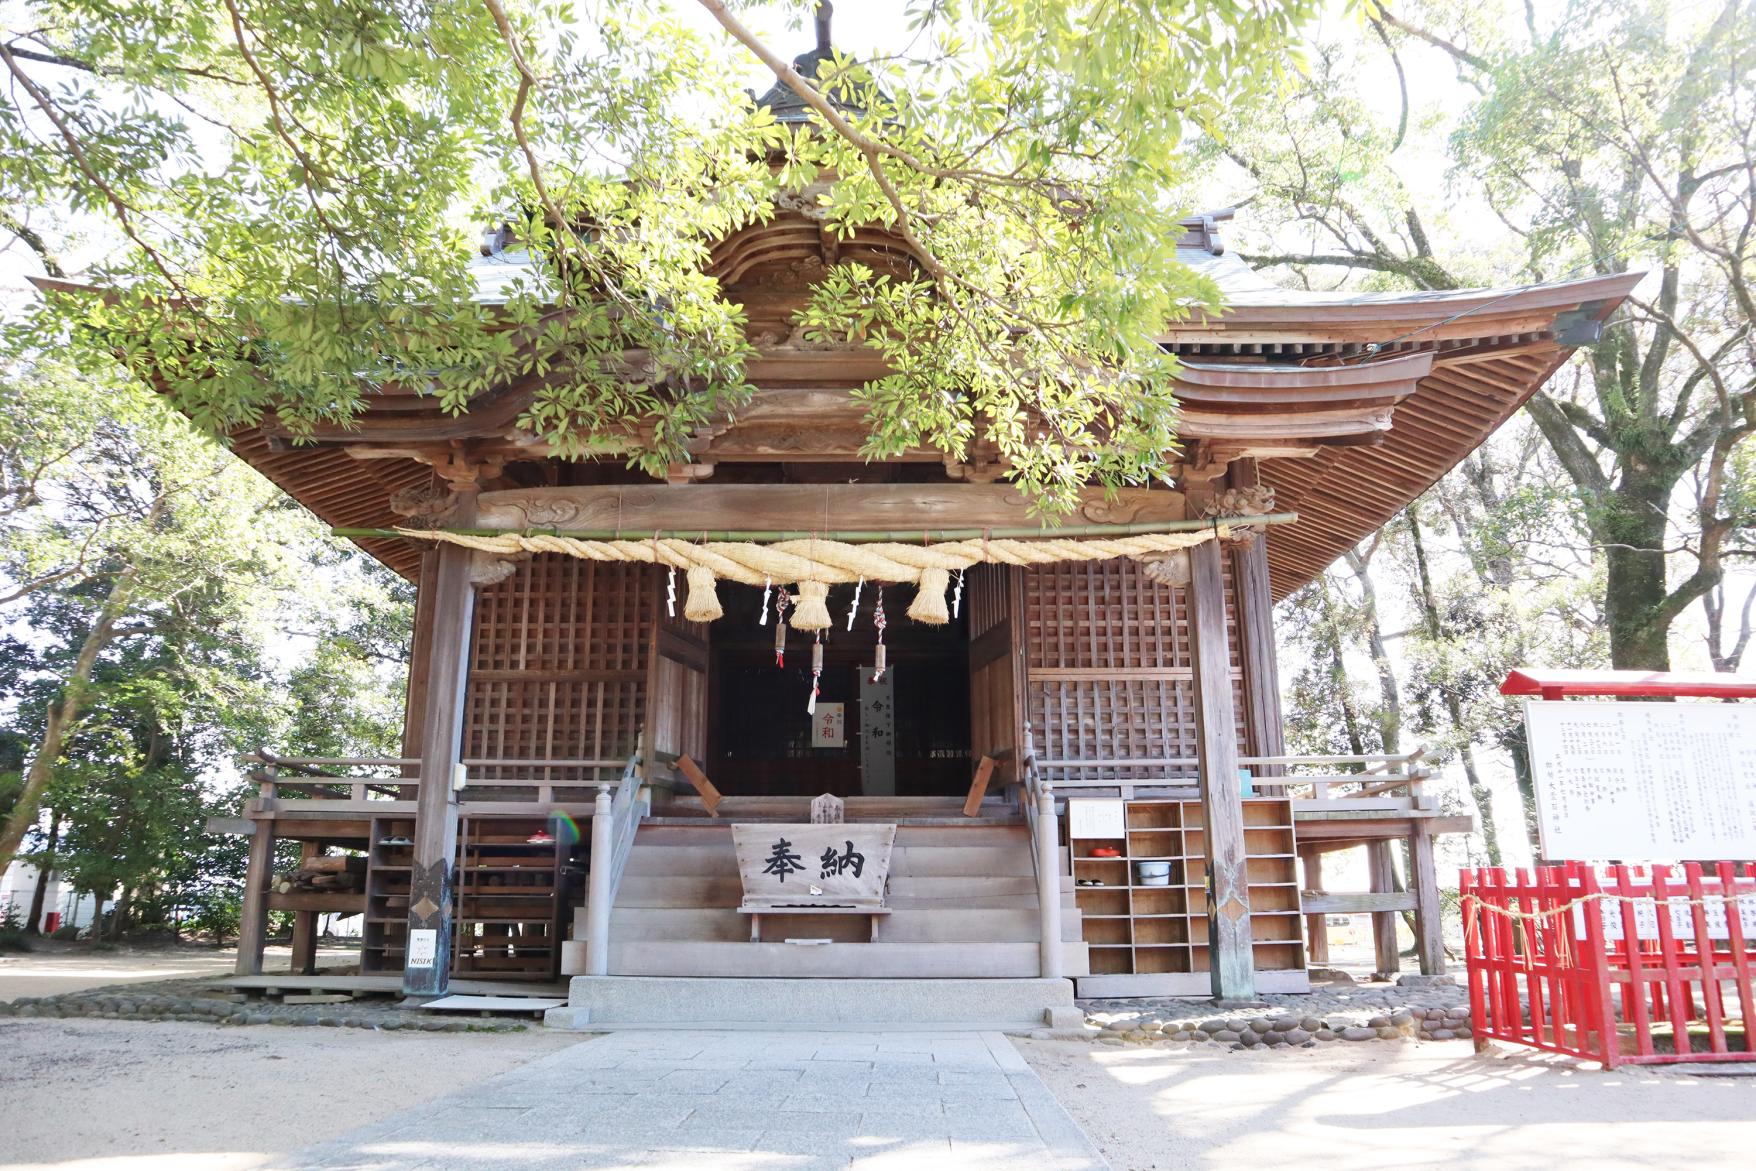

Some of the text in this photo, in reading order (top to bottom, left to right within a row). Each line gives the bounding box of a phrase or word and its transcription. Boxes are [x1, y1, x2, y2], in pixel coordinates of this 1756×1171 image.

[822, 712, 834, 740] 令和
[871, 700, 884, 739] 令和
[762, 837, 866, 883] 奉納
